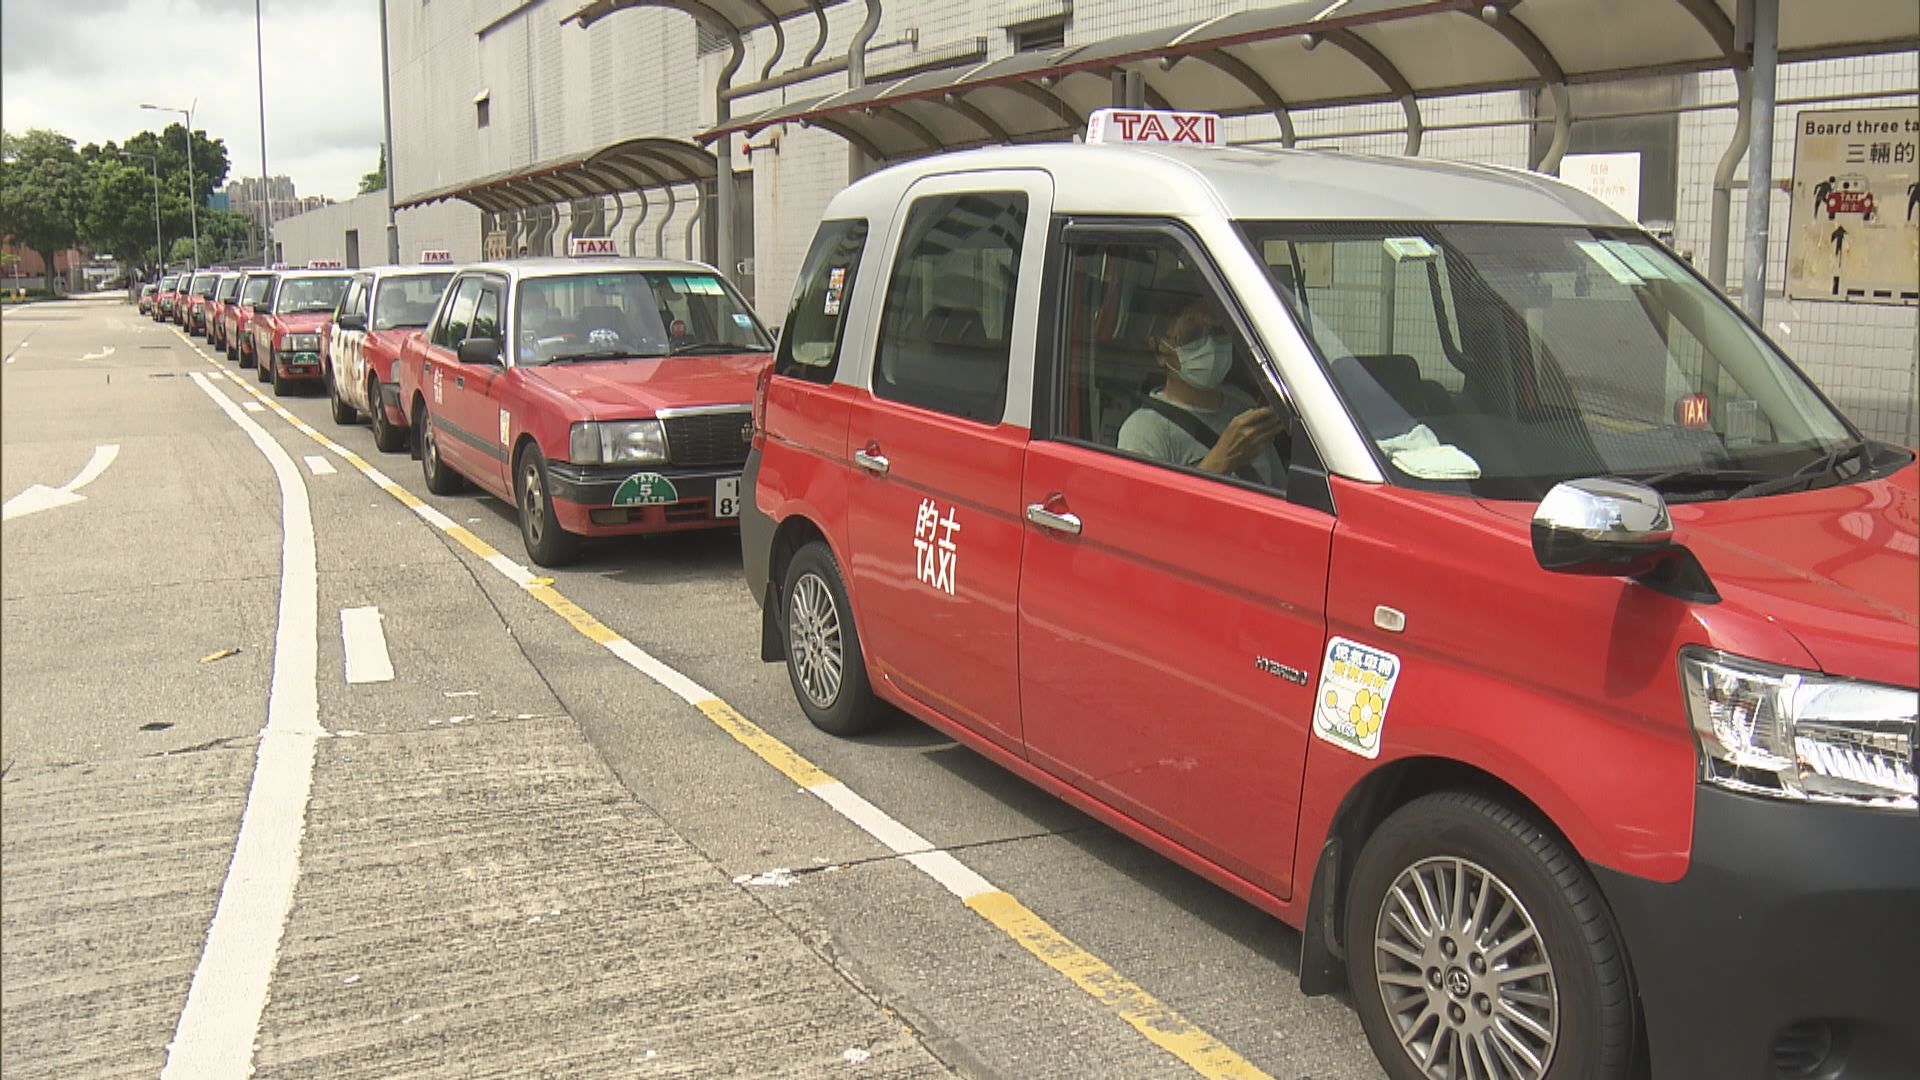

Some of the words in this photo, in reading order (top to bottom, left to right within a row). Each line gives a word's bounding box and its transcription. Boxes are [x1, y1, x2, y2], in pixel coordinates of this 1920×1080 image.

[1112, 112, 1215, 144] TAXI
[1805, 120, 1852, 135] Board
[1857, 119, 1899, 133] three
[1845, 142, 1916, 165] 三輛的
[577, 240, 613, 253] TAXI
[425, 252, 450, 262] TAXI
[1683, 398, 1708, 425] TAXI
[632, 475, 659, 486] TAXI
[639, 484, 652, 496] 5
[915, 497, 961, 552] 的士
[913, 538, 957, 596] TAXI
